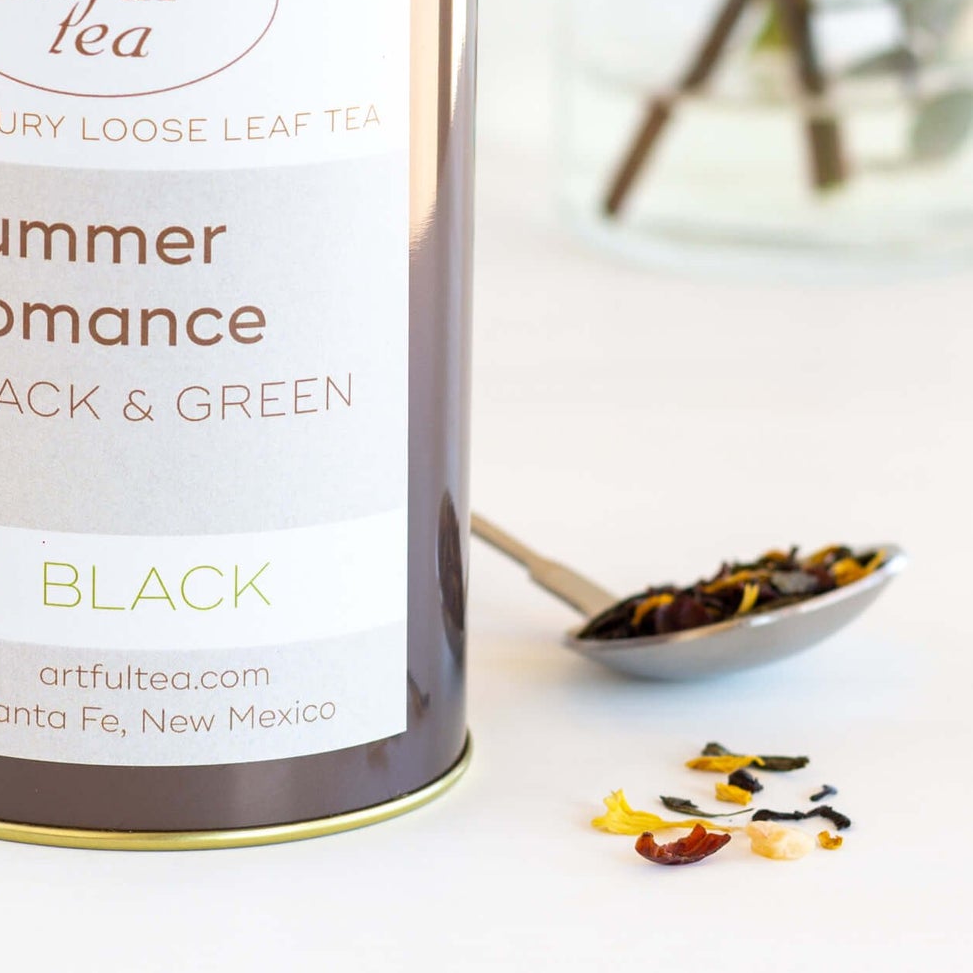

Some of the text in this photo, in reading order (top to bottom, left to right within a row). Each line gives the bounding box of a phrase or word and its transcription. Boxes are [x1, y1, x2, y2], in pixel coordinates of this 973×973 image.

[48, 2, 153, 58] tea
[81, 115, 208, 143] LOOSE
[223, 112, 312, 141] LEAF
[323, 103, 382, 133] TEA
[122, 389, 155, 422] &
[176, 372, 353, 423] GREEN
[42, 561, 271, 611] BLACK
[38, 663, 270, 691] artfultea.com
[81, 706, 127, 738] Fe,
[141, 708, 215, 734] New
[229, 700, 337, 731] Mexico
